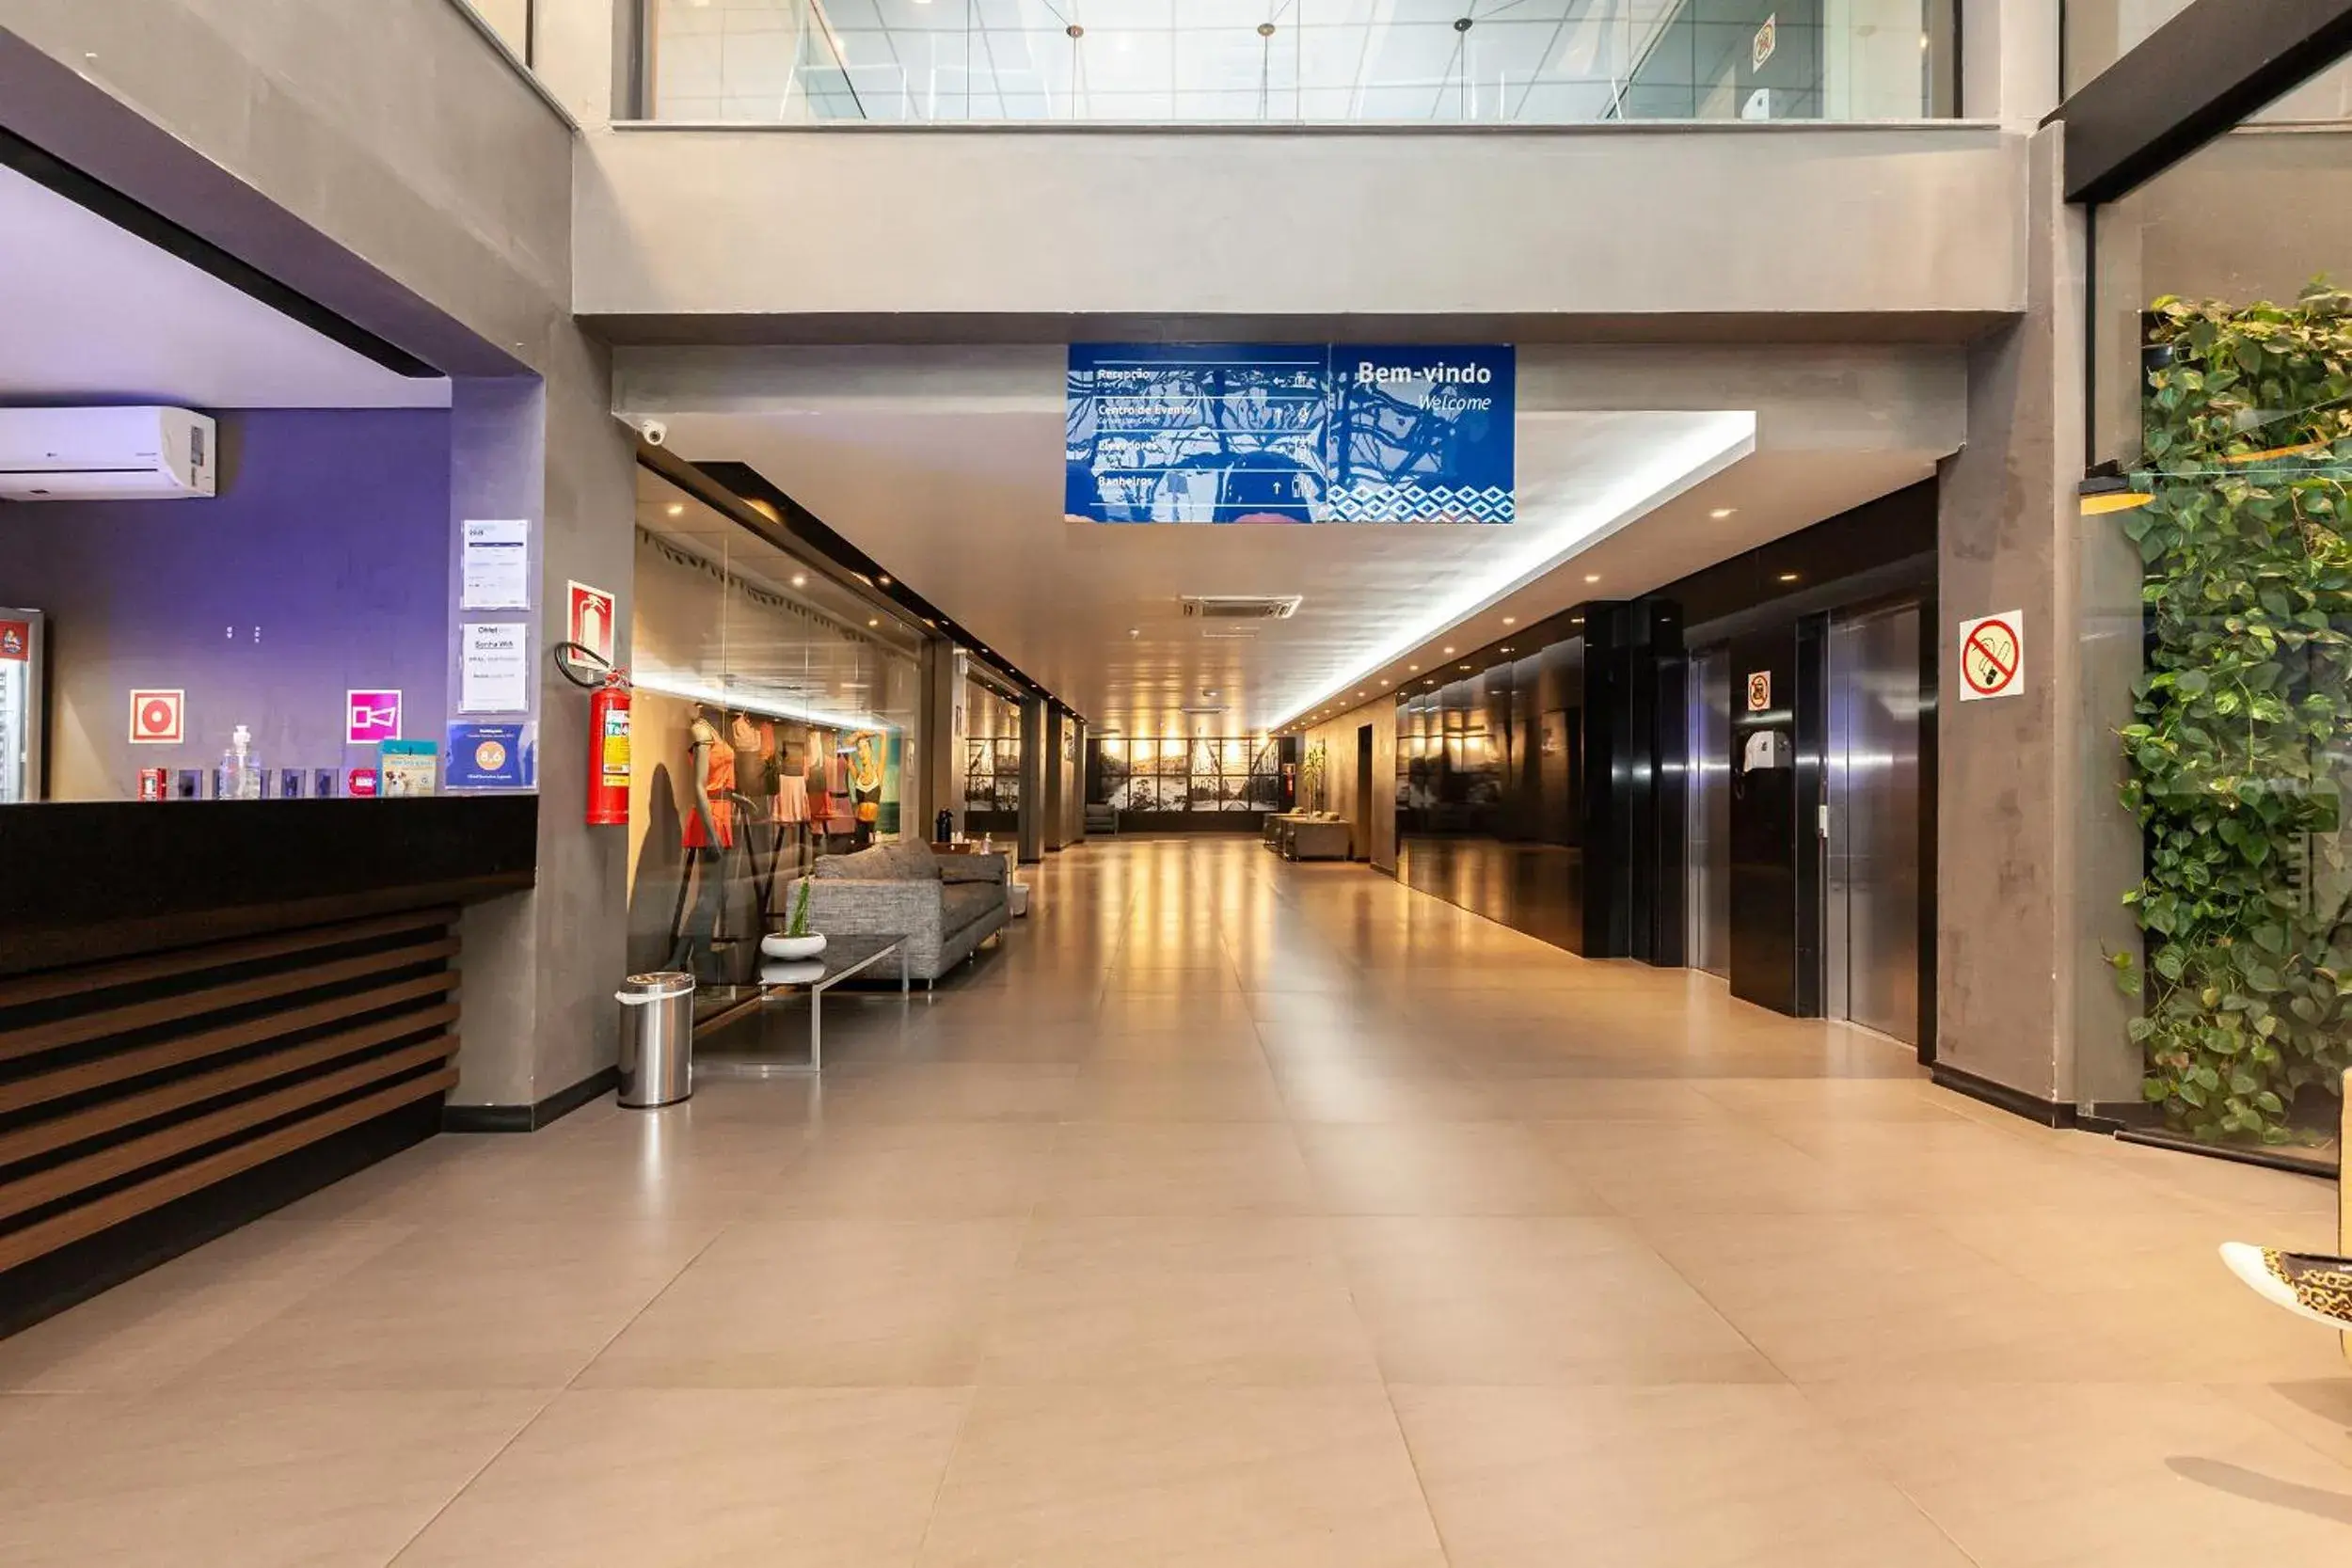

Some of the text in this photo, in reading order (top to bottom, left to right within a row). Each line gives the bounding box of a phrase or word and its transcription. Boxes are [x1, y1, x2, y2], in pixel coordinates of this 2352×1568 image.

[1096, 368, 1151, 381] Recepção
[1359, 361, 1492, 384] Bem-vindo
[1419, 393, 1492, 411] Welcome
[1098, 404, 1198, 415] Centro de Eventos
[1098, 476, 1153, 486] Banheiros
[480, 750, 501, 762] 8.6
